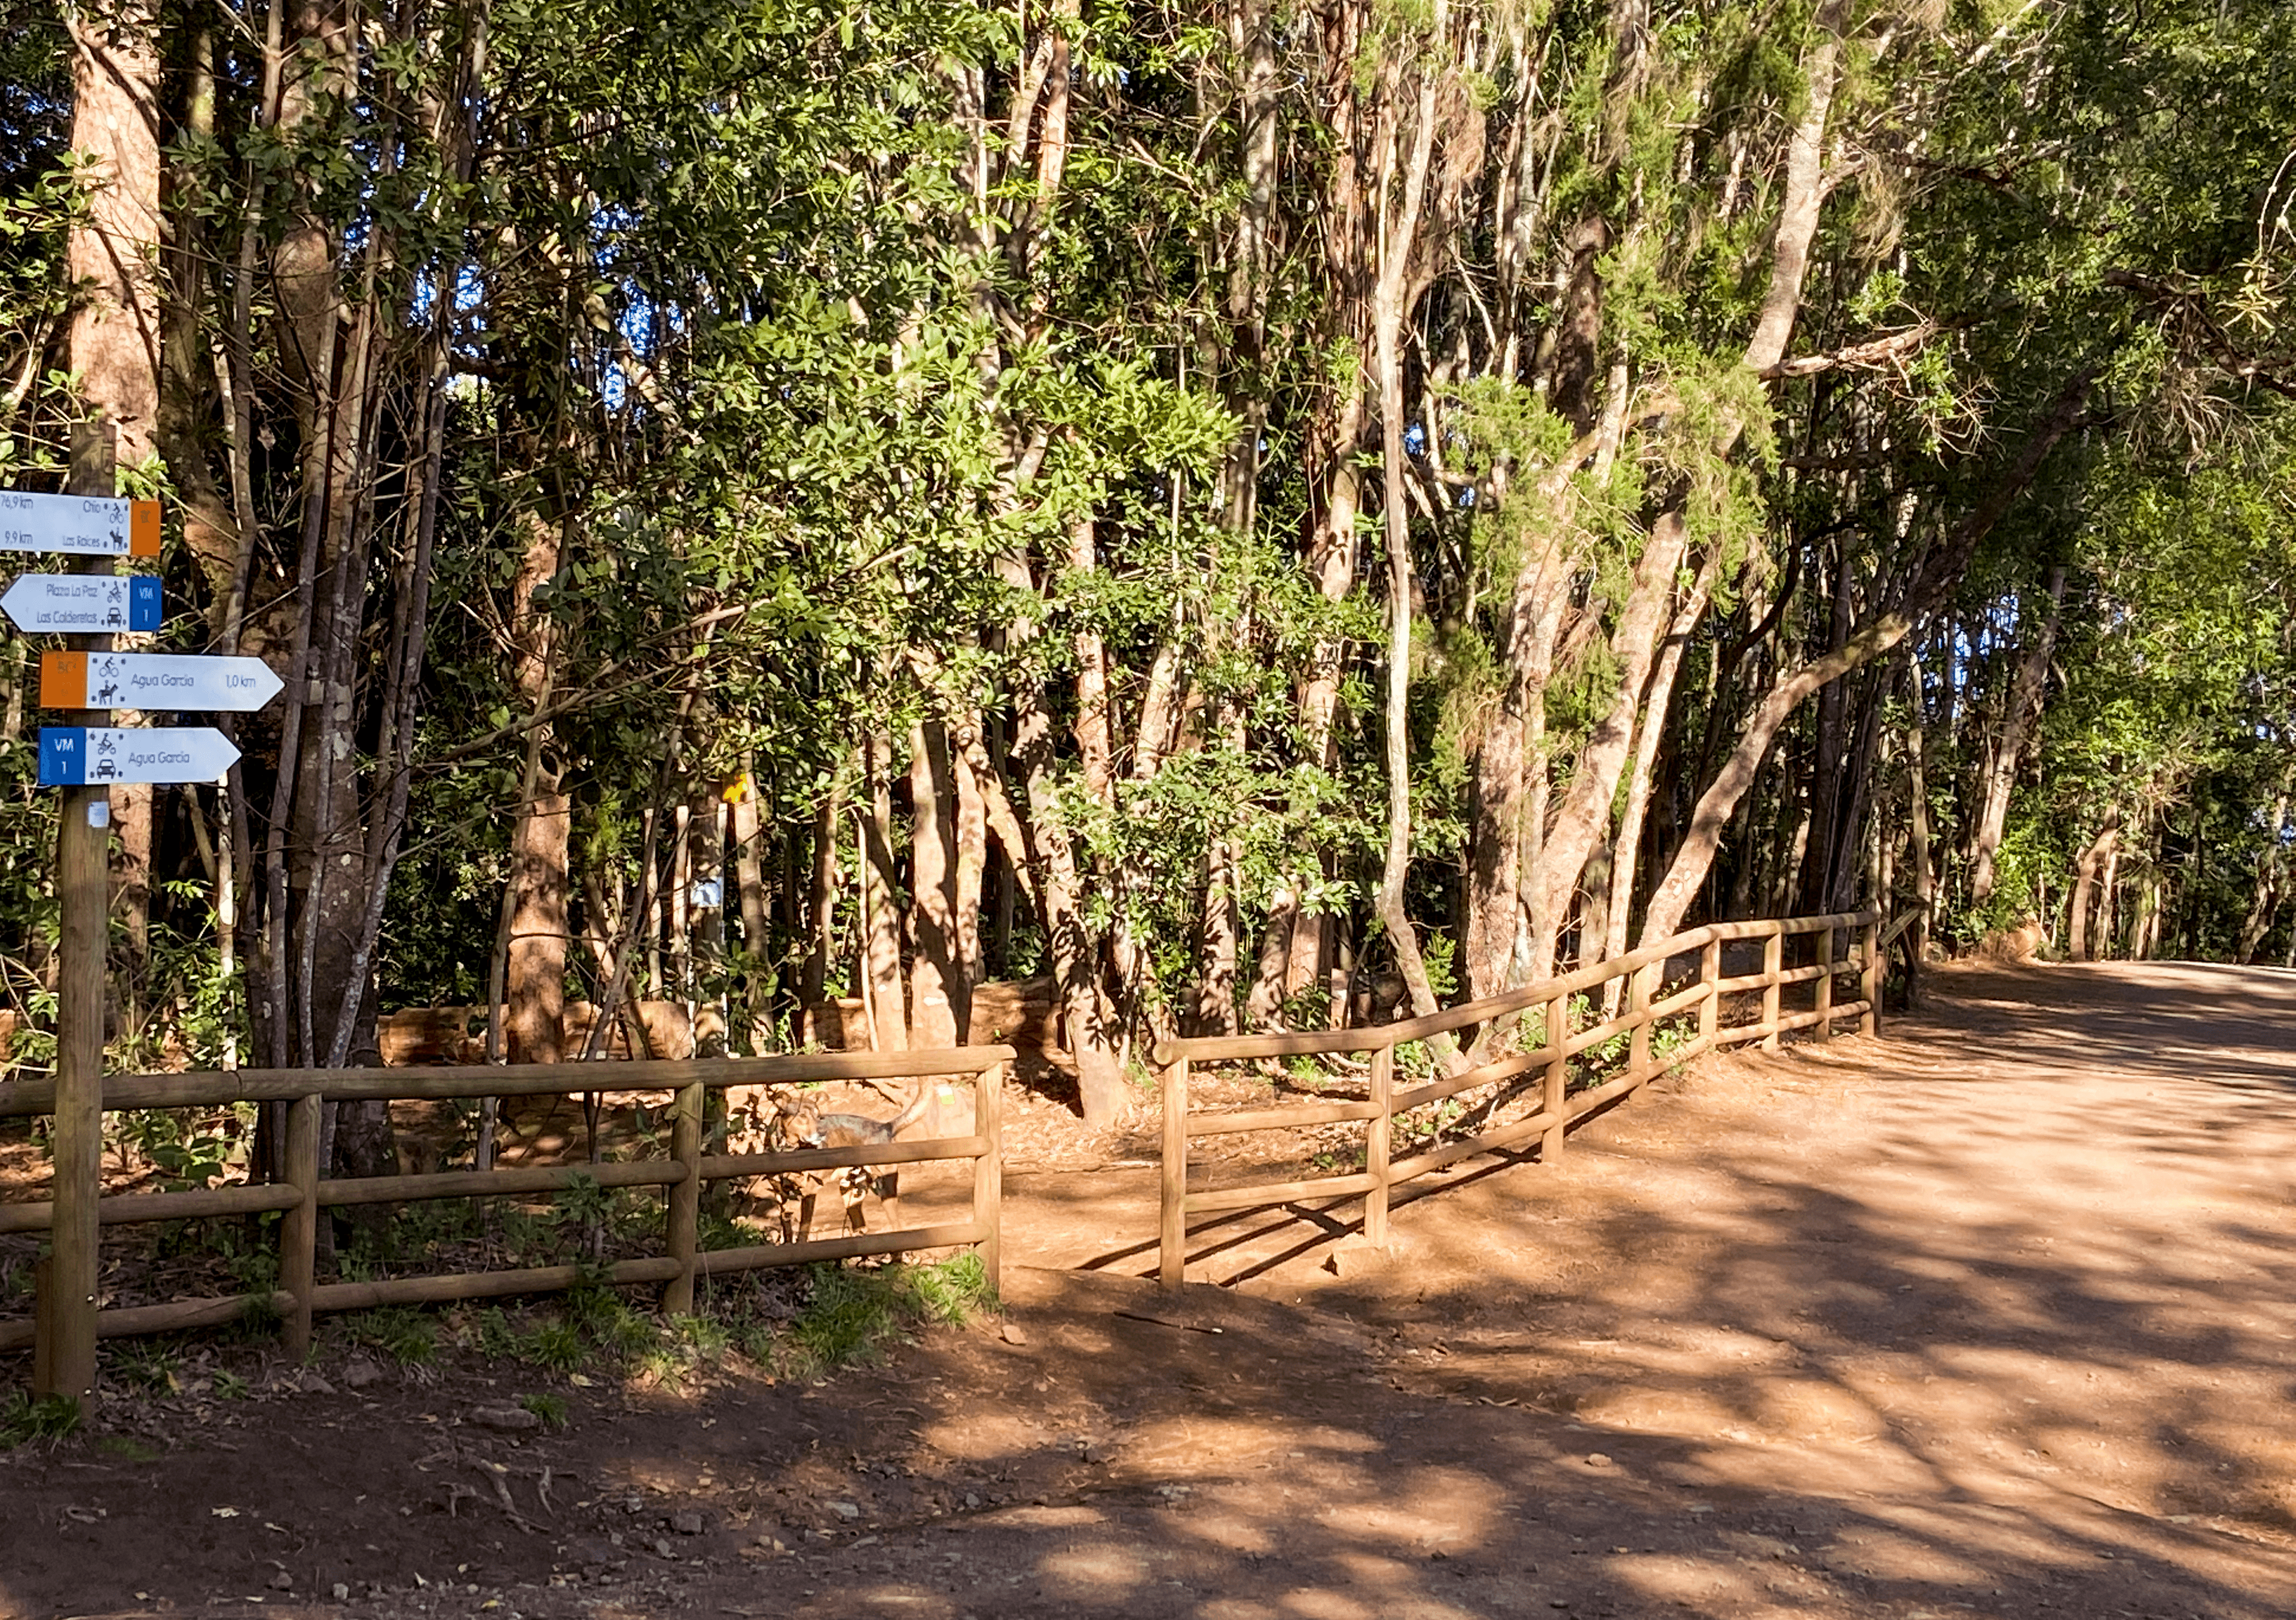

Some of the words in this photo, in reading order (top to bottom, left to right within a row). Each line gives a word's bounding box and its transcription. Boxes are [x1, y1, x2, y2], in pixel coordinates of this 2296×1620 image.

[20, 495, 33, 509] km
[19, 530, 33, 544] km
[62, 535, 75, 547] Las
[46, 583, 70, 597] Plaza
[71, 583, 81, 597] La
[83, 584, 98, 598] Paz
[139, 586, 154, 600] VM
[36, 611, 51, 623] Las
[130, 673, 159, 690] Agua
[240, 674, 257, 688] km
[54, 738, 75, 753] VM
[128, 751, 155, 768] Agua
[60, 761, 67, 775] 1
